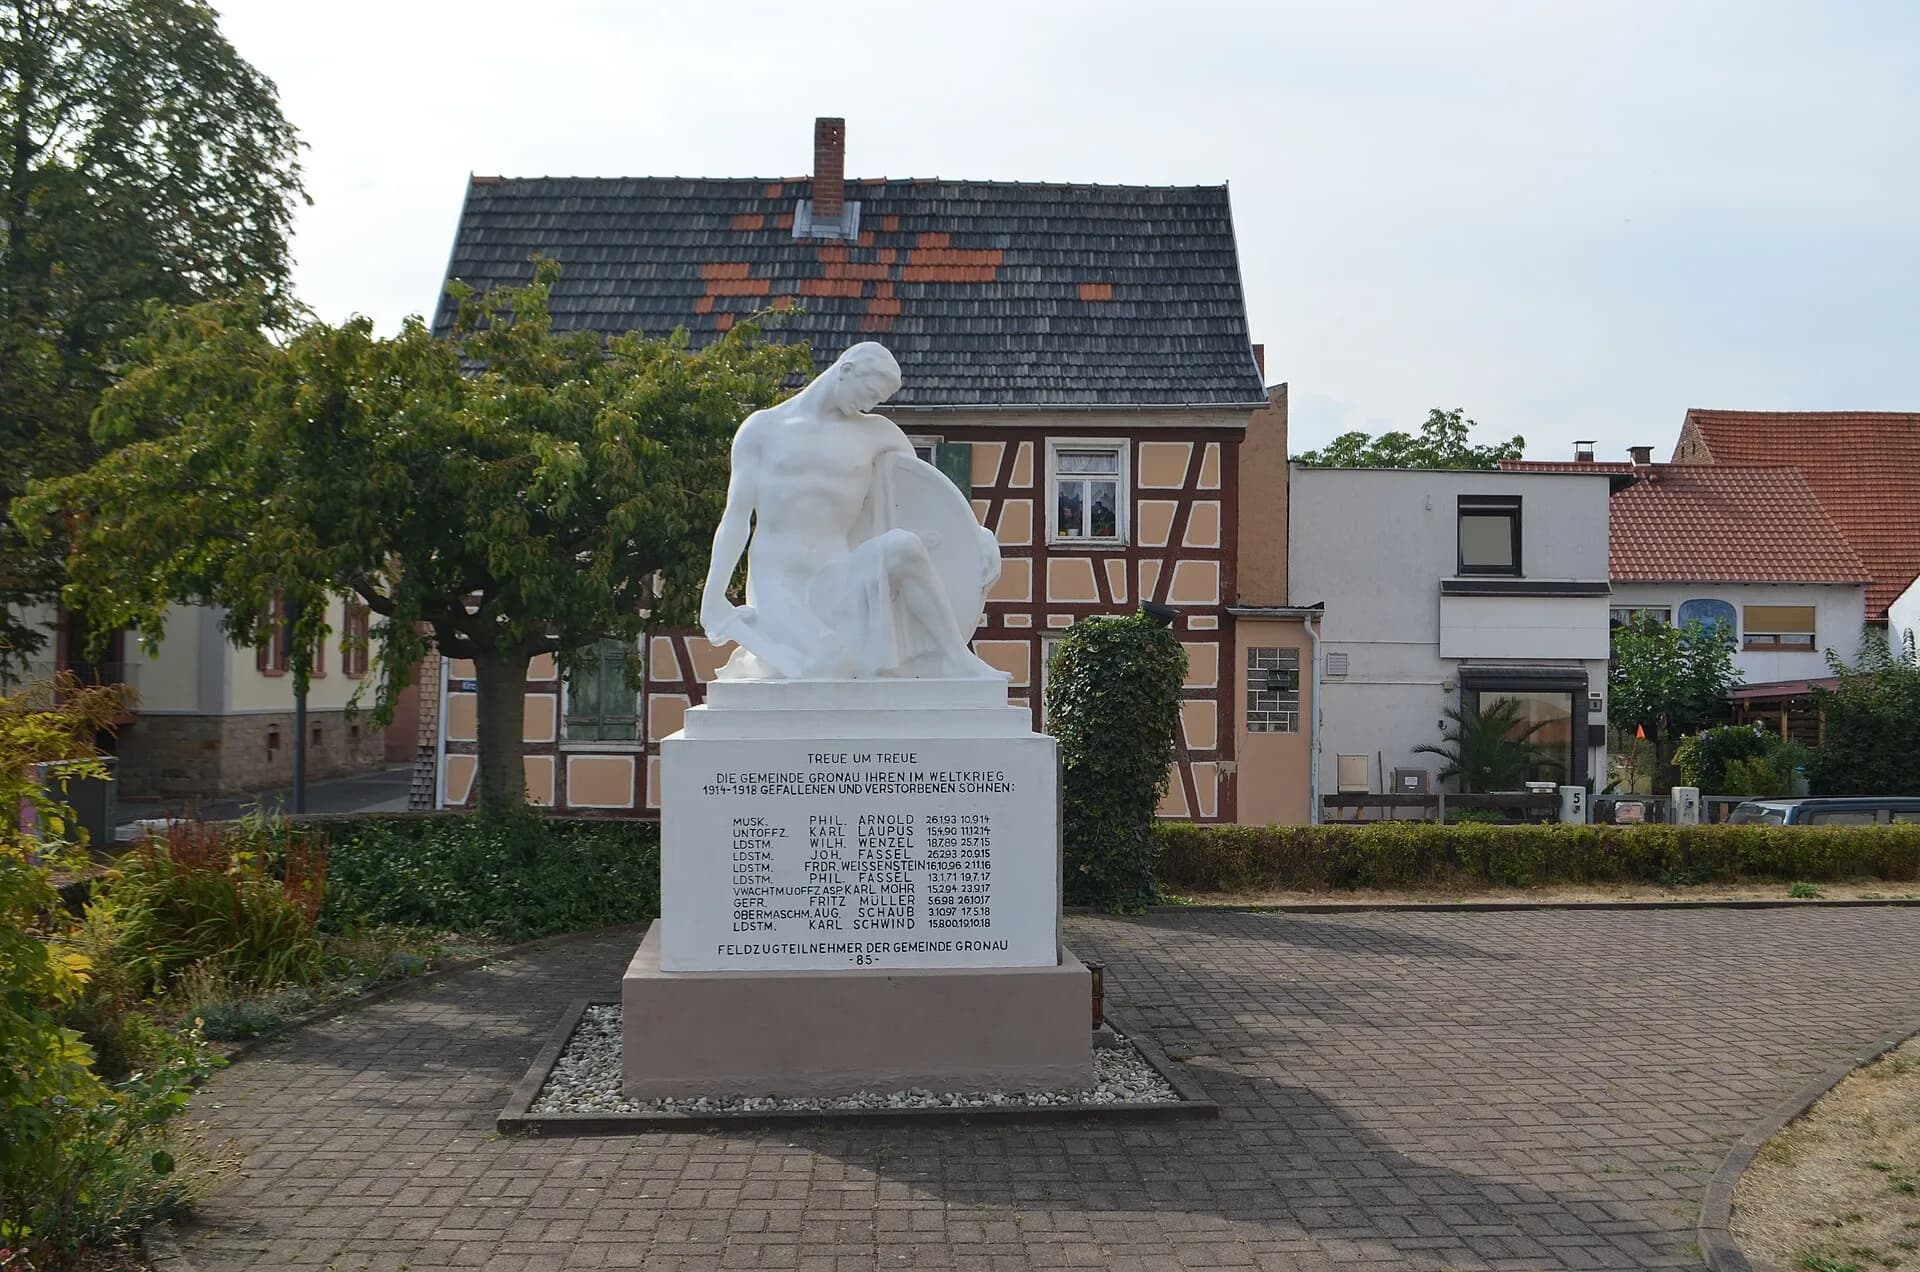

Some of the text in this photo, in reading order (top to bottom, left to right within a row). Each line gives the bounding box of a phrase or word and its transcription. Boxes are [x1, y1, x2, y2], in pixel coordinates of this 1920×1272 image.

[807, 752, 918, 765] TREUE UM TREUE
[716, 770, 1005, 785] DIE GEMEINDE GRONAU IHREN IM WELTKRIEG
[702, 784, 758, 796] 1914-1918
[760, 783, 836, 796] GEFALLENEN
[838, 783, 863, 795] UND
[864, 782, 956, 795] VERSTORBENEN
[1573, 792, 1580, 804] 5
[858, 814, 915, 826] ARNOLD
[809, 825, 846, 838] KARL
[857, 825, 914, 837] LAUPUS
[858, 836, 915, 849] WENZEL
[858, 847, 912, 860] FASSEL
[840, 859, 926, 872] WEISSENSTEIN
[858, 871, 913, 884] FASSEL
[844, 883, 877, 895] KARL
[880, 883, 915, 895] MOHR
[809, 895, 847, 907] FRITZ
[859, 894, 916, 907] MÜLLER
[857, 905, 915, 918] SCHAUB
[808, 919, 844, 931] KARL
[853, 917, 916, 930] SCHWIND
[717, 939, 1009, 956] FELDZUGTEILNEHMER DER GEMEINDE GRONAU
